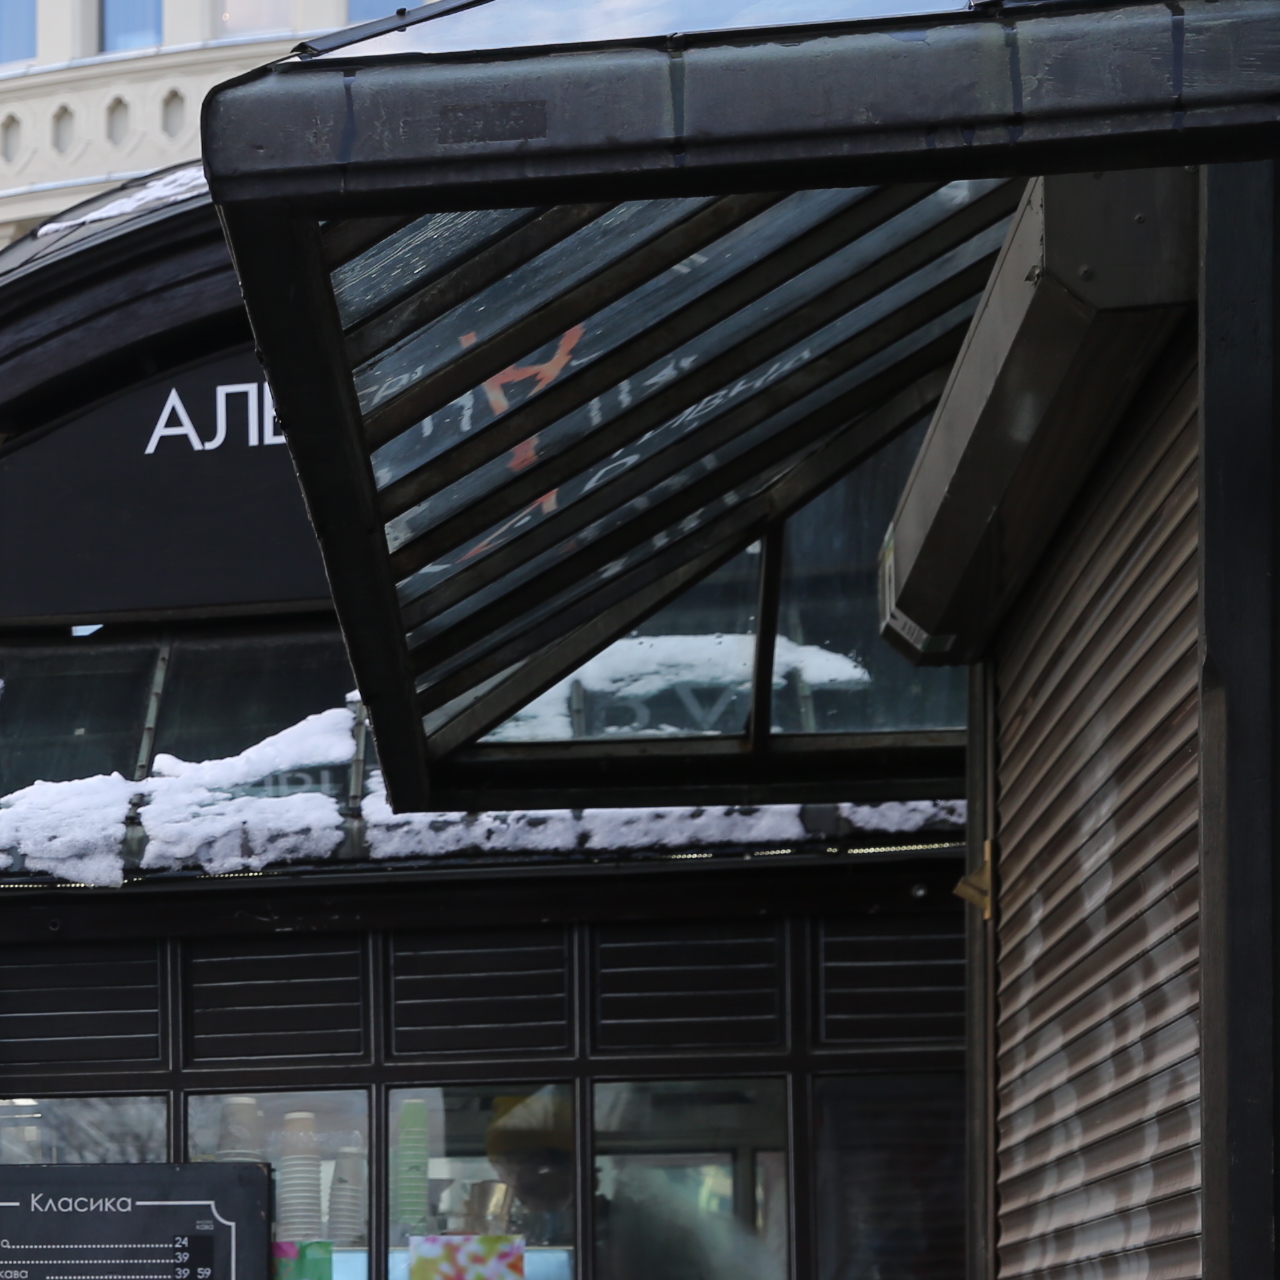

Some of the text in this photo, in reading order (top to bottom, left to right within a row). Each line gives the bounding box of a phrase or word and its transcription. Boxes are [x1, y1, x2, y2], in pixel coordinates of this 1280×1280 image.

[30, 1193, 132, 1213] Класика
[174, 1236, 189, 1248] 24
[174, 1252, 190, 1264] 39
[174, 1267, 190, 1279] 39
[196, 1267, 212, 1279] 59
